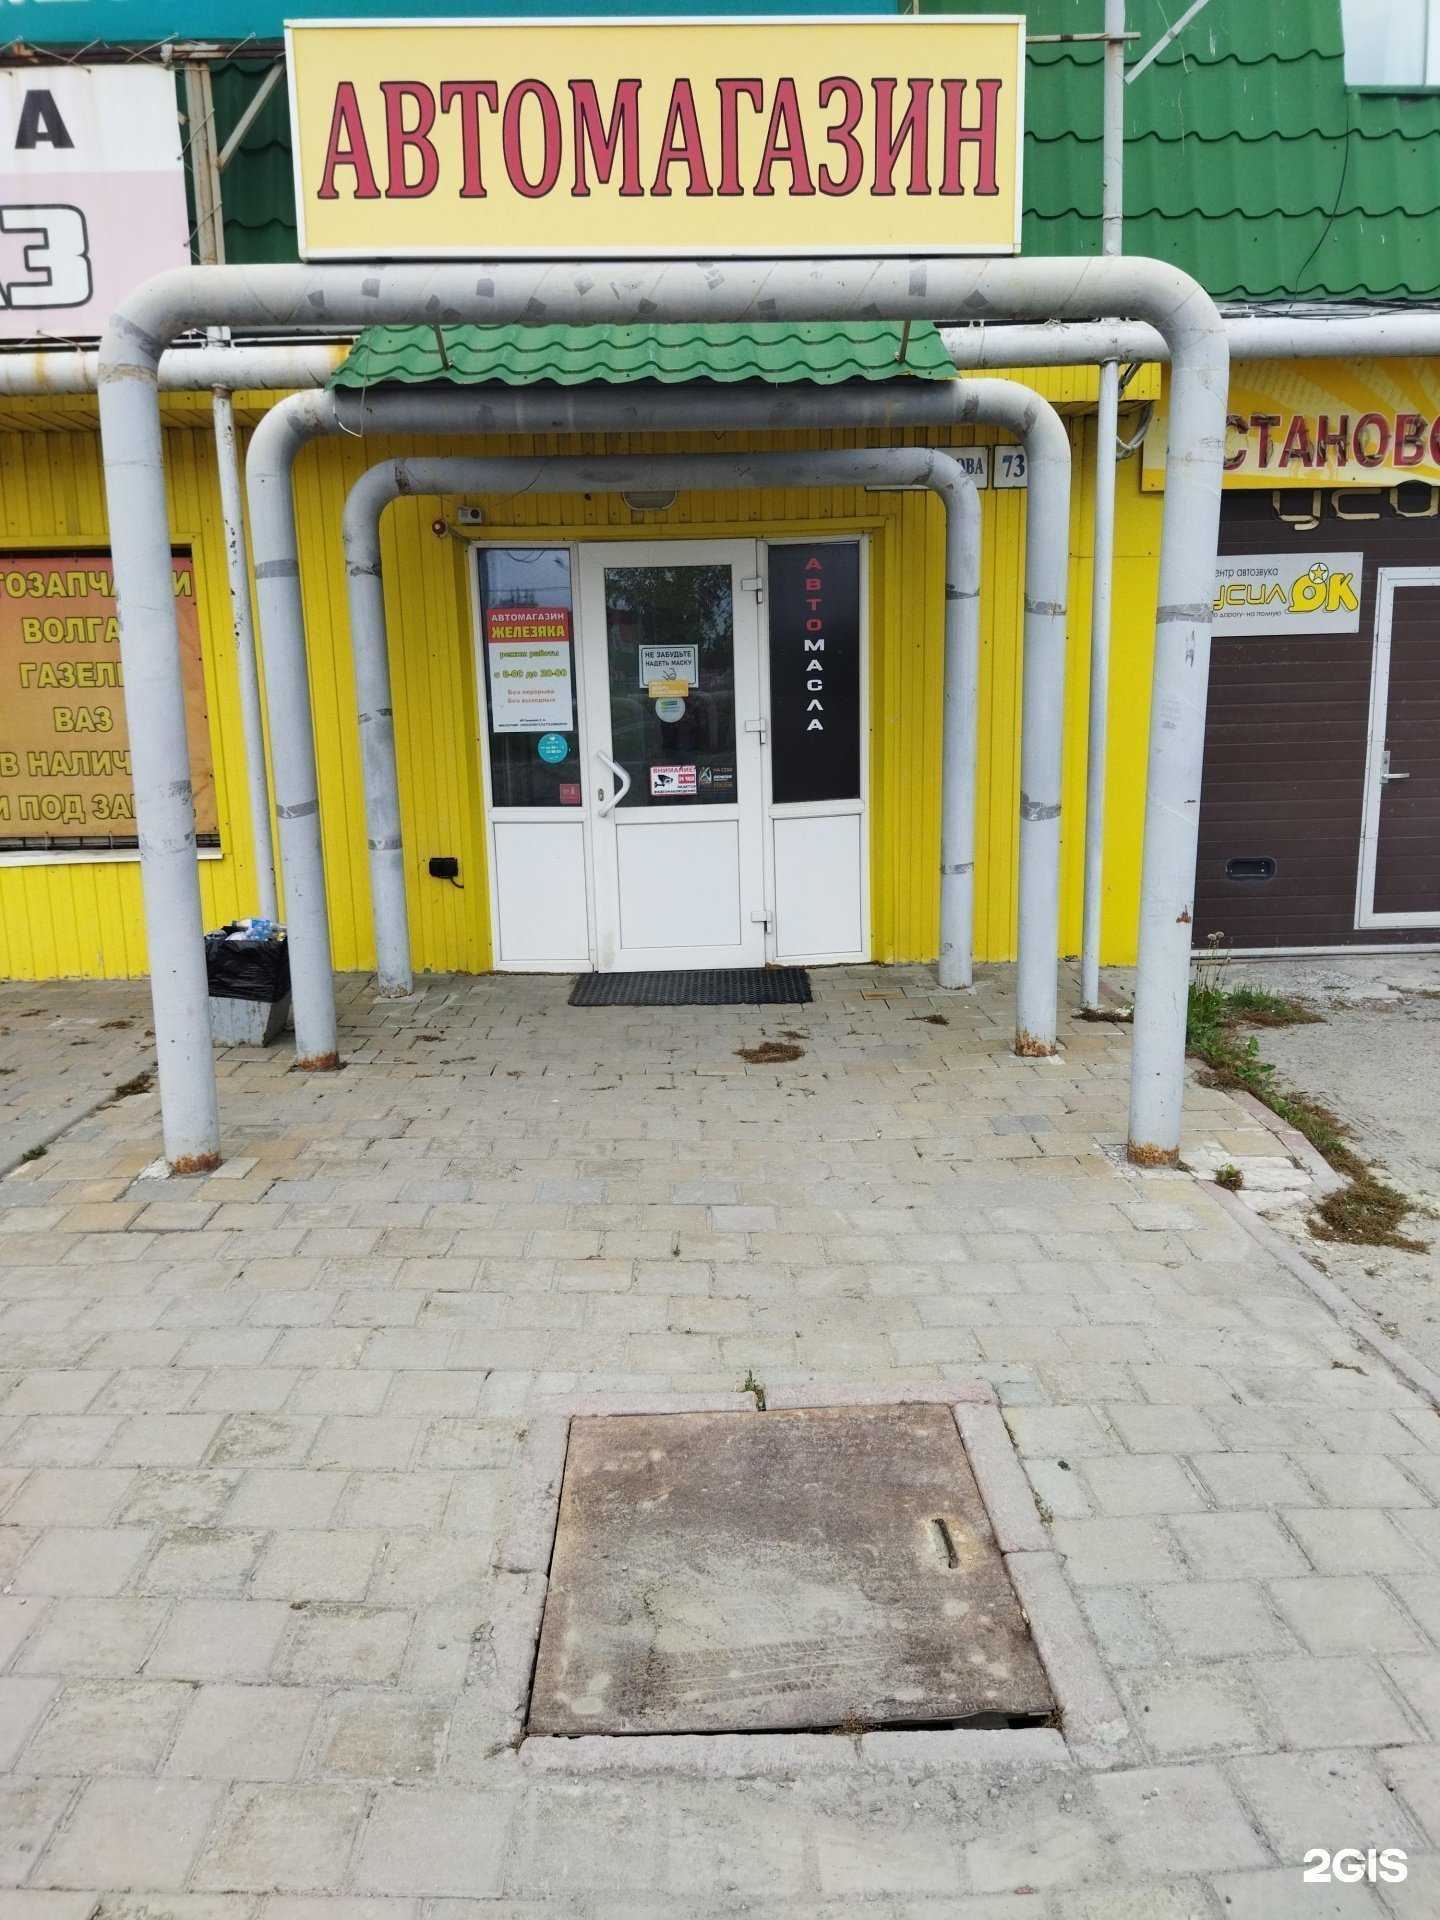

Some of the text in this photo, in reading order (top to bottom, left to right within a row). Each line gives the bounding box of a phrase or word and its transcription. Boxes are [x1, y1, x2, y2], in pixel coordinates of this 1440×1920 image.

[15, 89, 74, 149] А
[317, 76, 1002, 199] АВТОМАГАЗИН
[0, 204, 93, 310] З
[1002, 454, 1025, 477] 73
[1237, 568, 1279, 577] автозвука
[22, 617, 121, 643] ВОЛГА
[492, 612, 564, 622] АВТОМАГАЗИН
[492, 624, 565, 638] ЖЕЛЕЗЯКА
[804, 558, 825, 731] АВТОМАСЛА
[53, 706, 113, 732] ВАЗ
[27, 751, 132, 776] НАЛИЧ
[18, 795, 86, 824] ПОД
